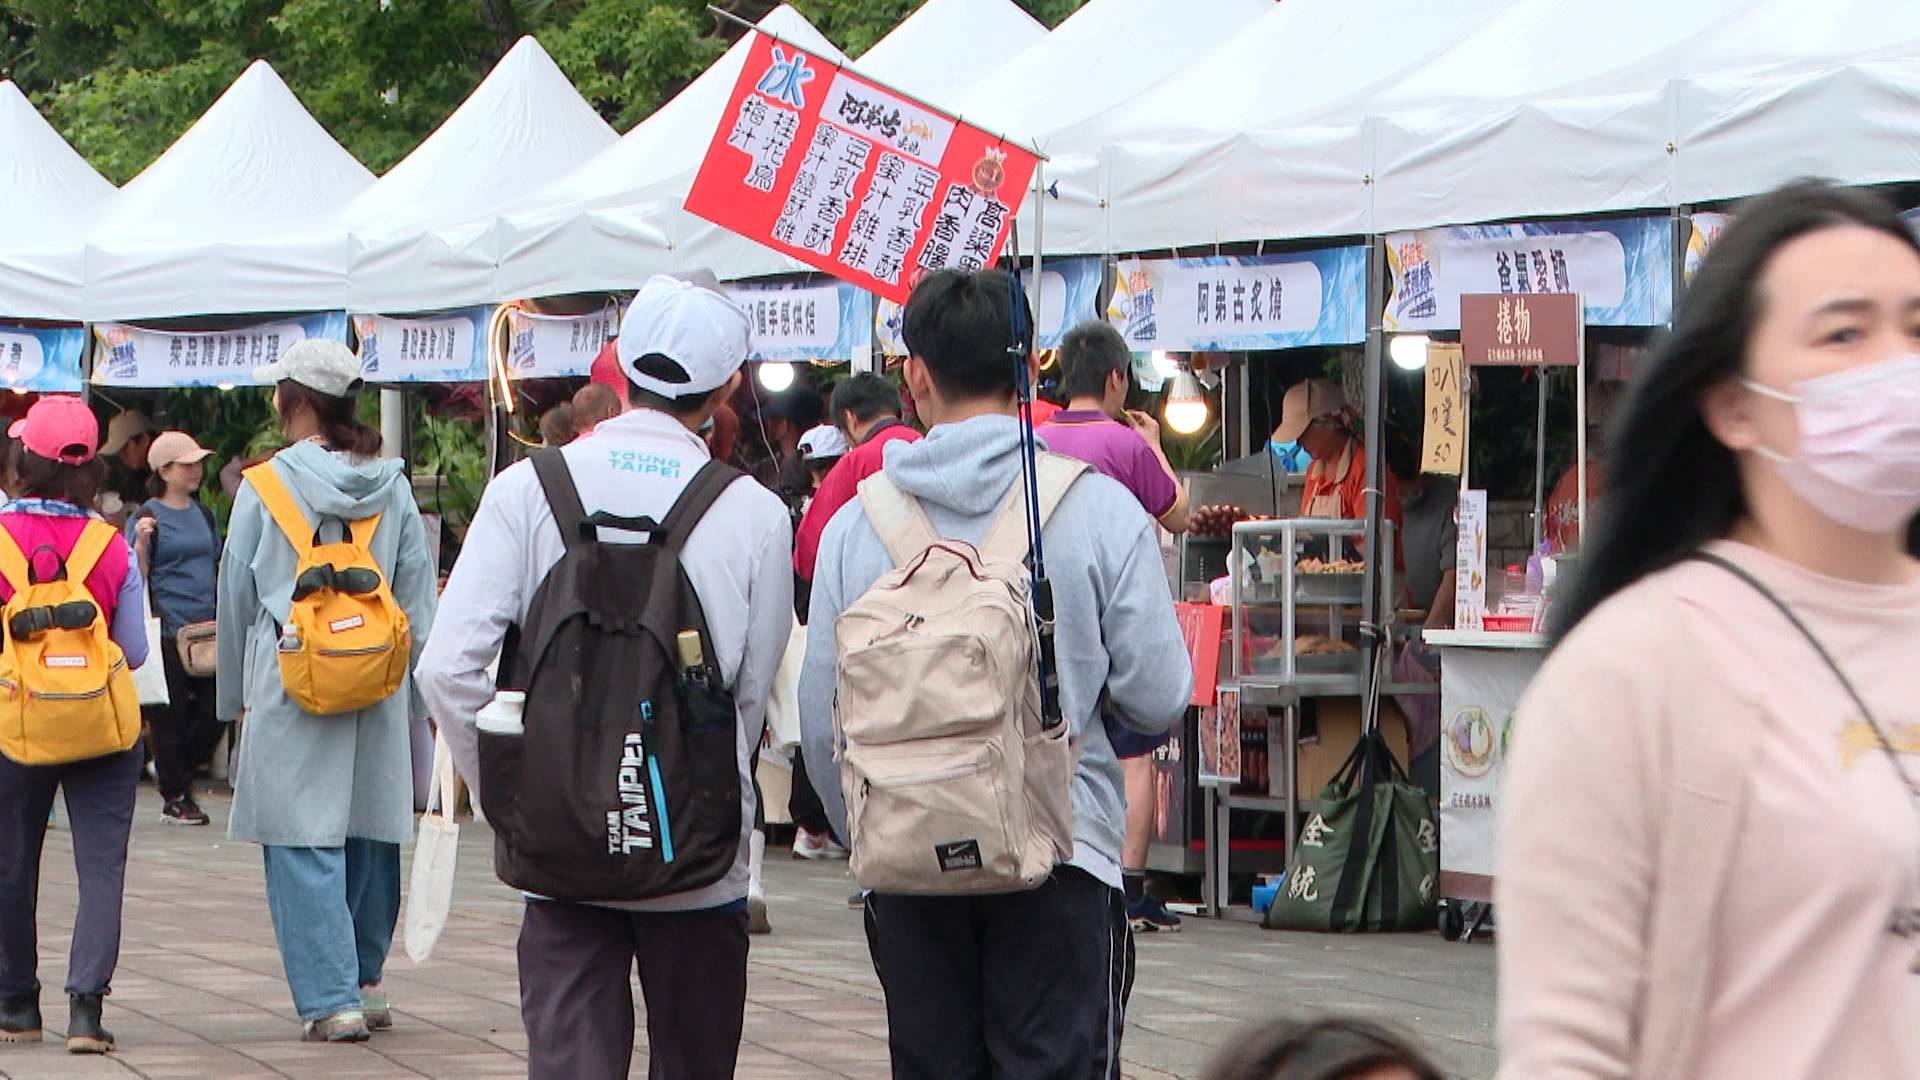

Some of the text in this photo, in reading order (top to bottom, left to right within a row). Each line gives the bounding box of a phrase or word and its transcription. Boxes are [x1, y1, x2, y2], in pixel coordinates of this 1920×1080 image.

[757, 47, 813, 106] 冰
[804, 138, 871, 254] 豆乳香酥
[840, 152, 905, 268] 蜜汁雞排
[875, 167, 941, 284] 豆乳香酥
[1197, 277, 1283, 324] 阿弟古炙燒
[1496, 296, 1531, 345] 捲物
[608, 459, 680, 479] TAIPEI
[609, 449, 681, 469] YOUNG
[617, 733, 653, 855] TAIPEI
[605, 810, 622, 855] TEAM
[1288, 813, 1334, 902] 全統
